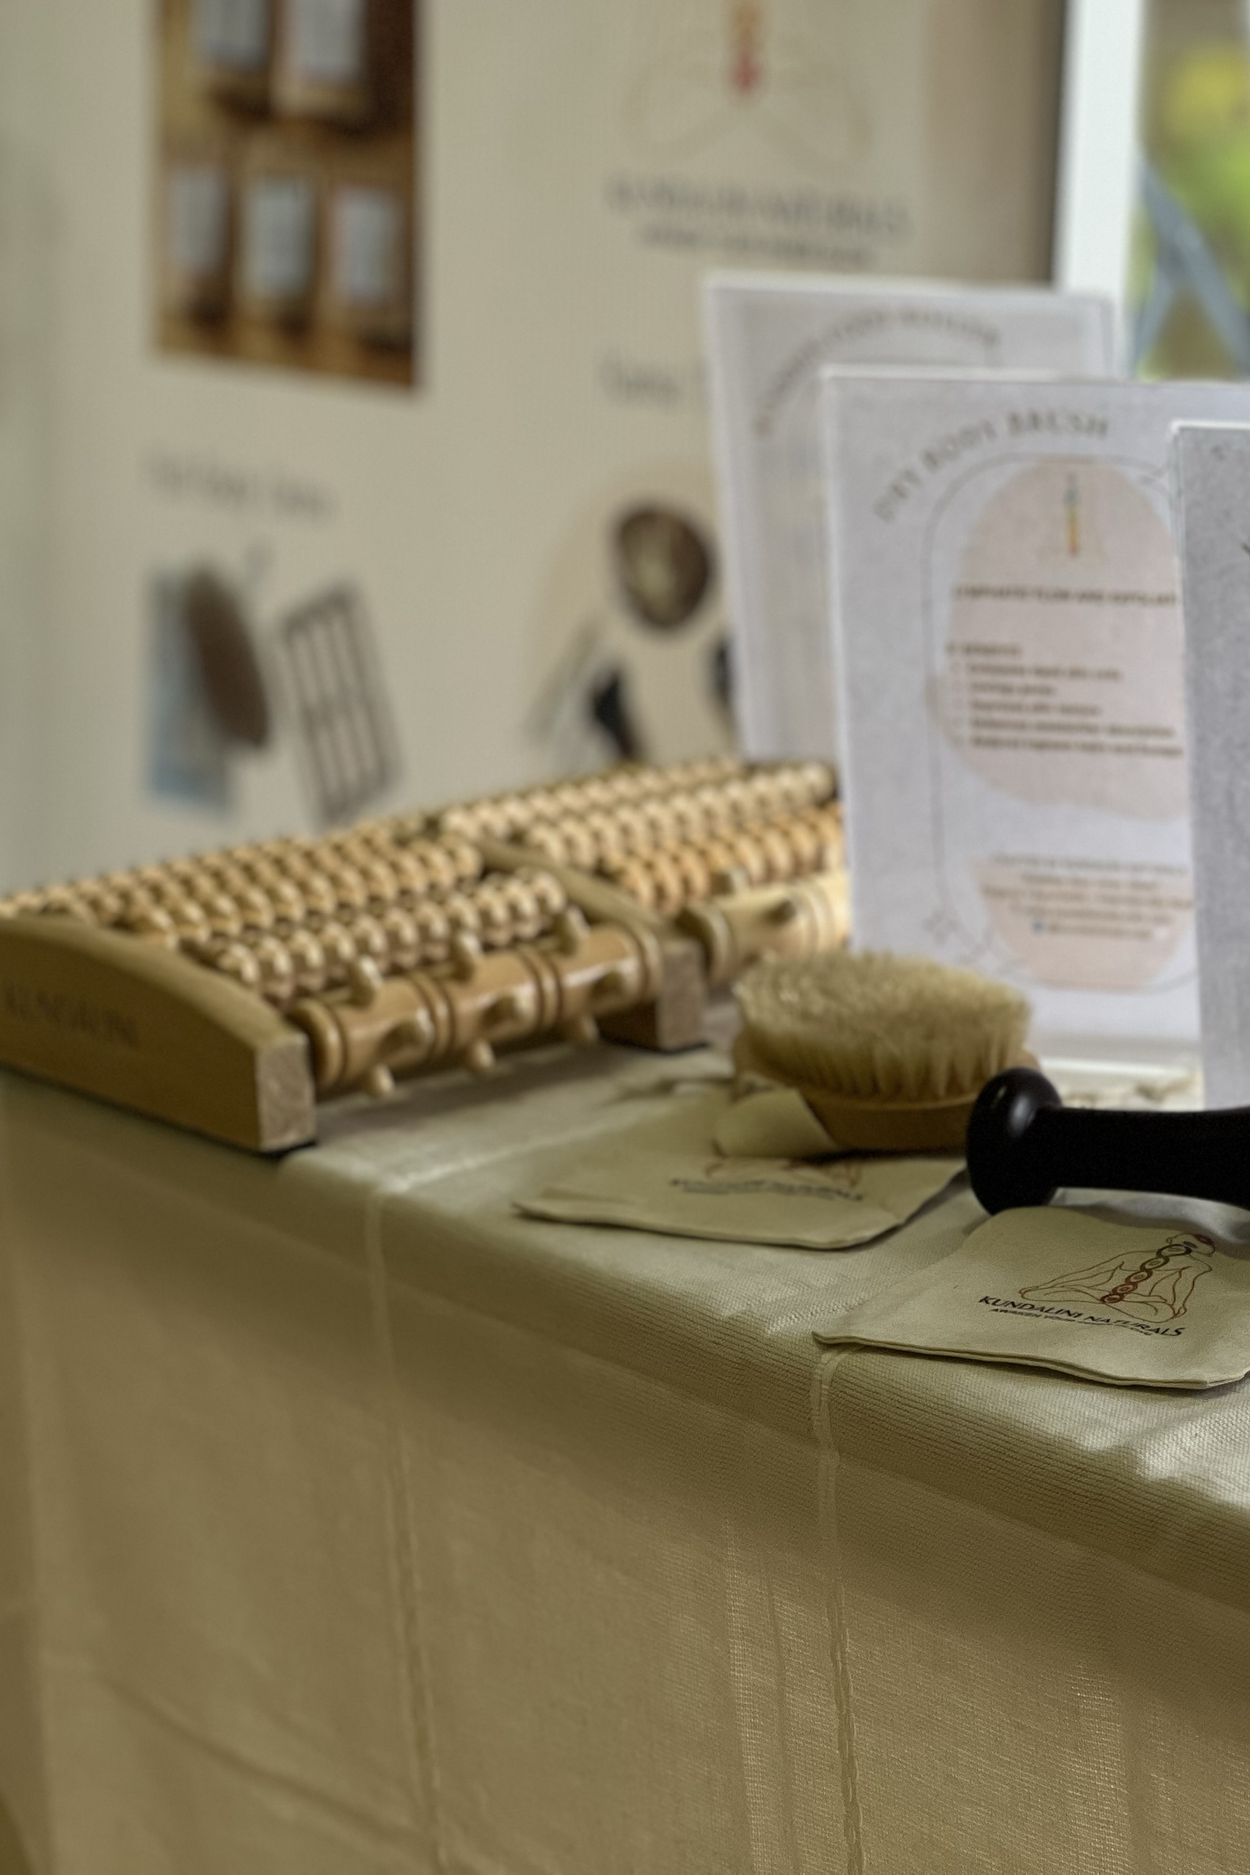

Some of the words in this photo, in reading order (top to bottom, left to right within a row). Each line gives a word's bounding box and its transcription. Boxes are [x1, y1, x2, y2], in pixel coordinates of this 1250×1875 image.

[1007, 407, 1109, 441] BRUSH
[979, 1295, 1082, 1318] KUNDALINI
[1084, 1315, 1186, 1337] NATURALS
